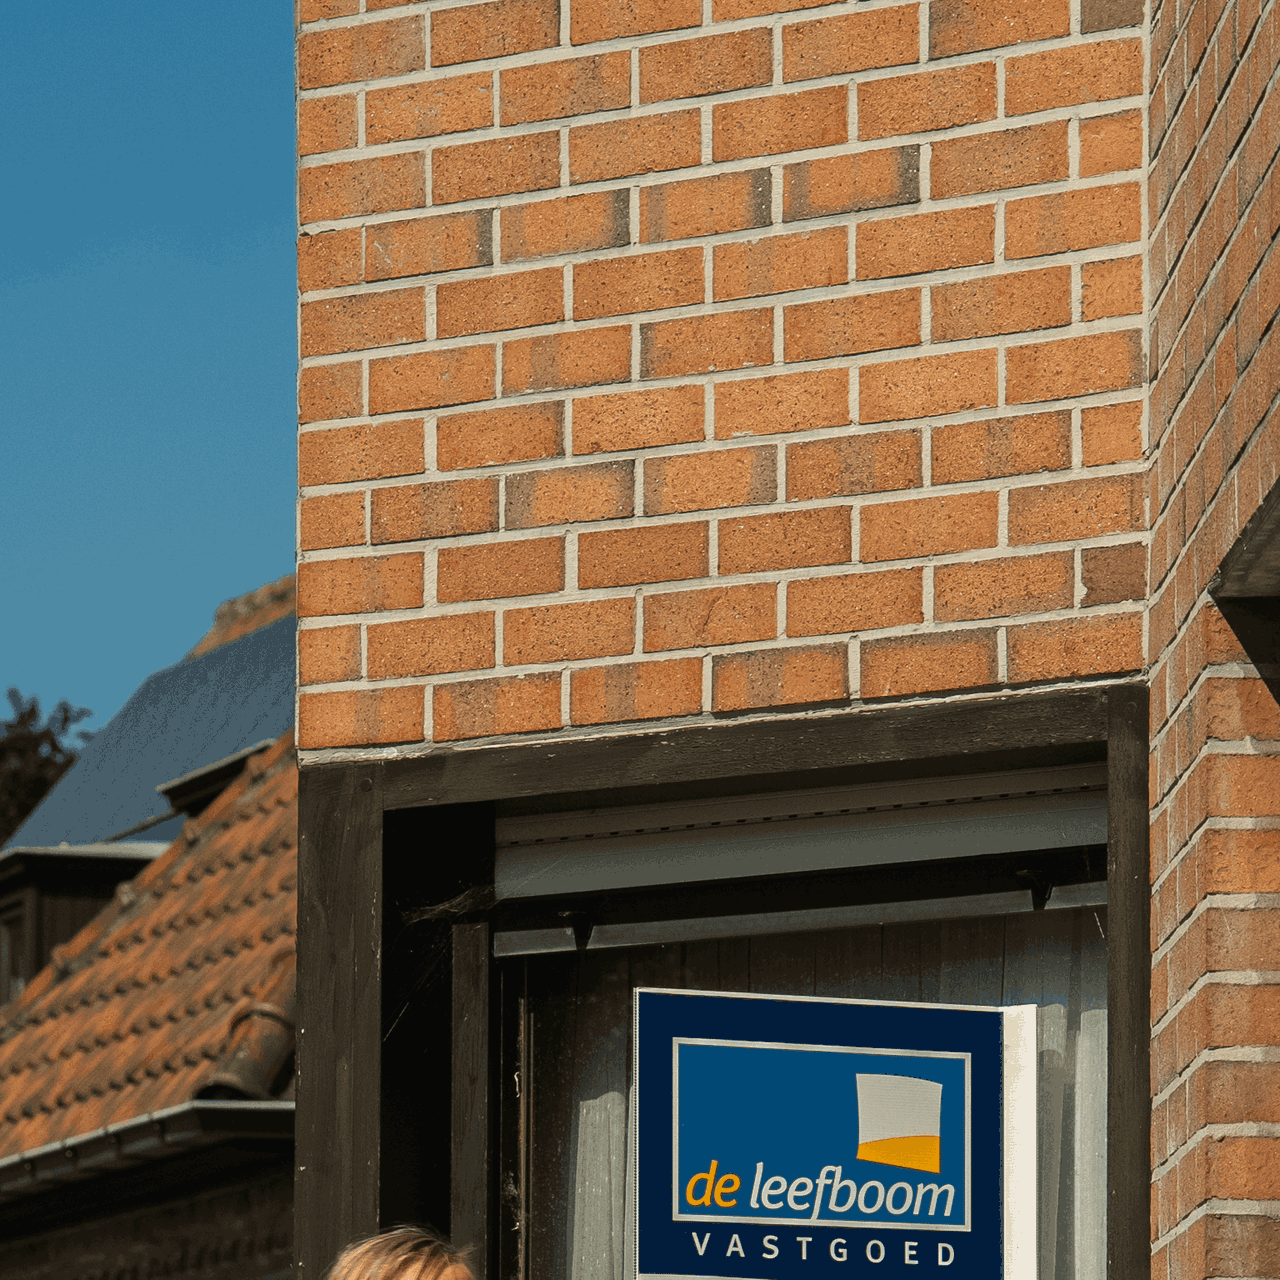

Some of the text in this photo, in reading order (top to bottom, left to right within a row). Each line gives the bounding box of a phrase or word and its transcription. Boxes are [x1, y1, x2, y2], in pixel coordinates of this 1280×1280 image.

[685, 1159, 955, 1220] de leefboom
[691, 1232, 955, 1266] VASTGOED
